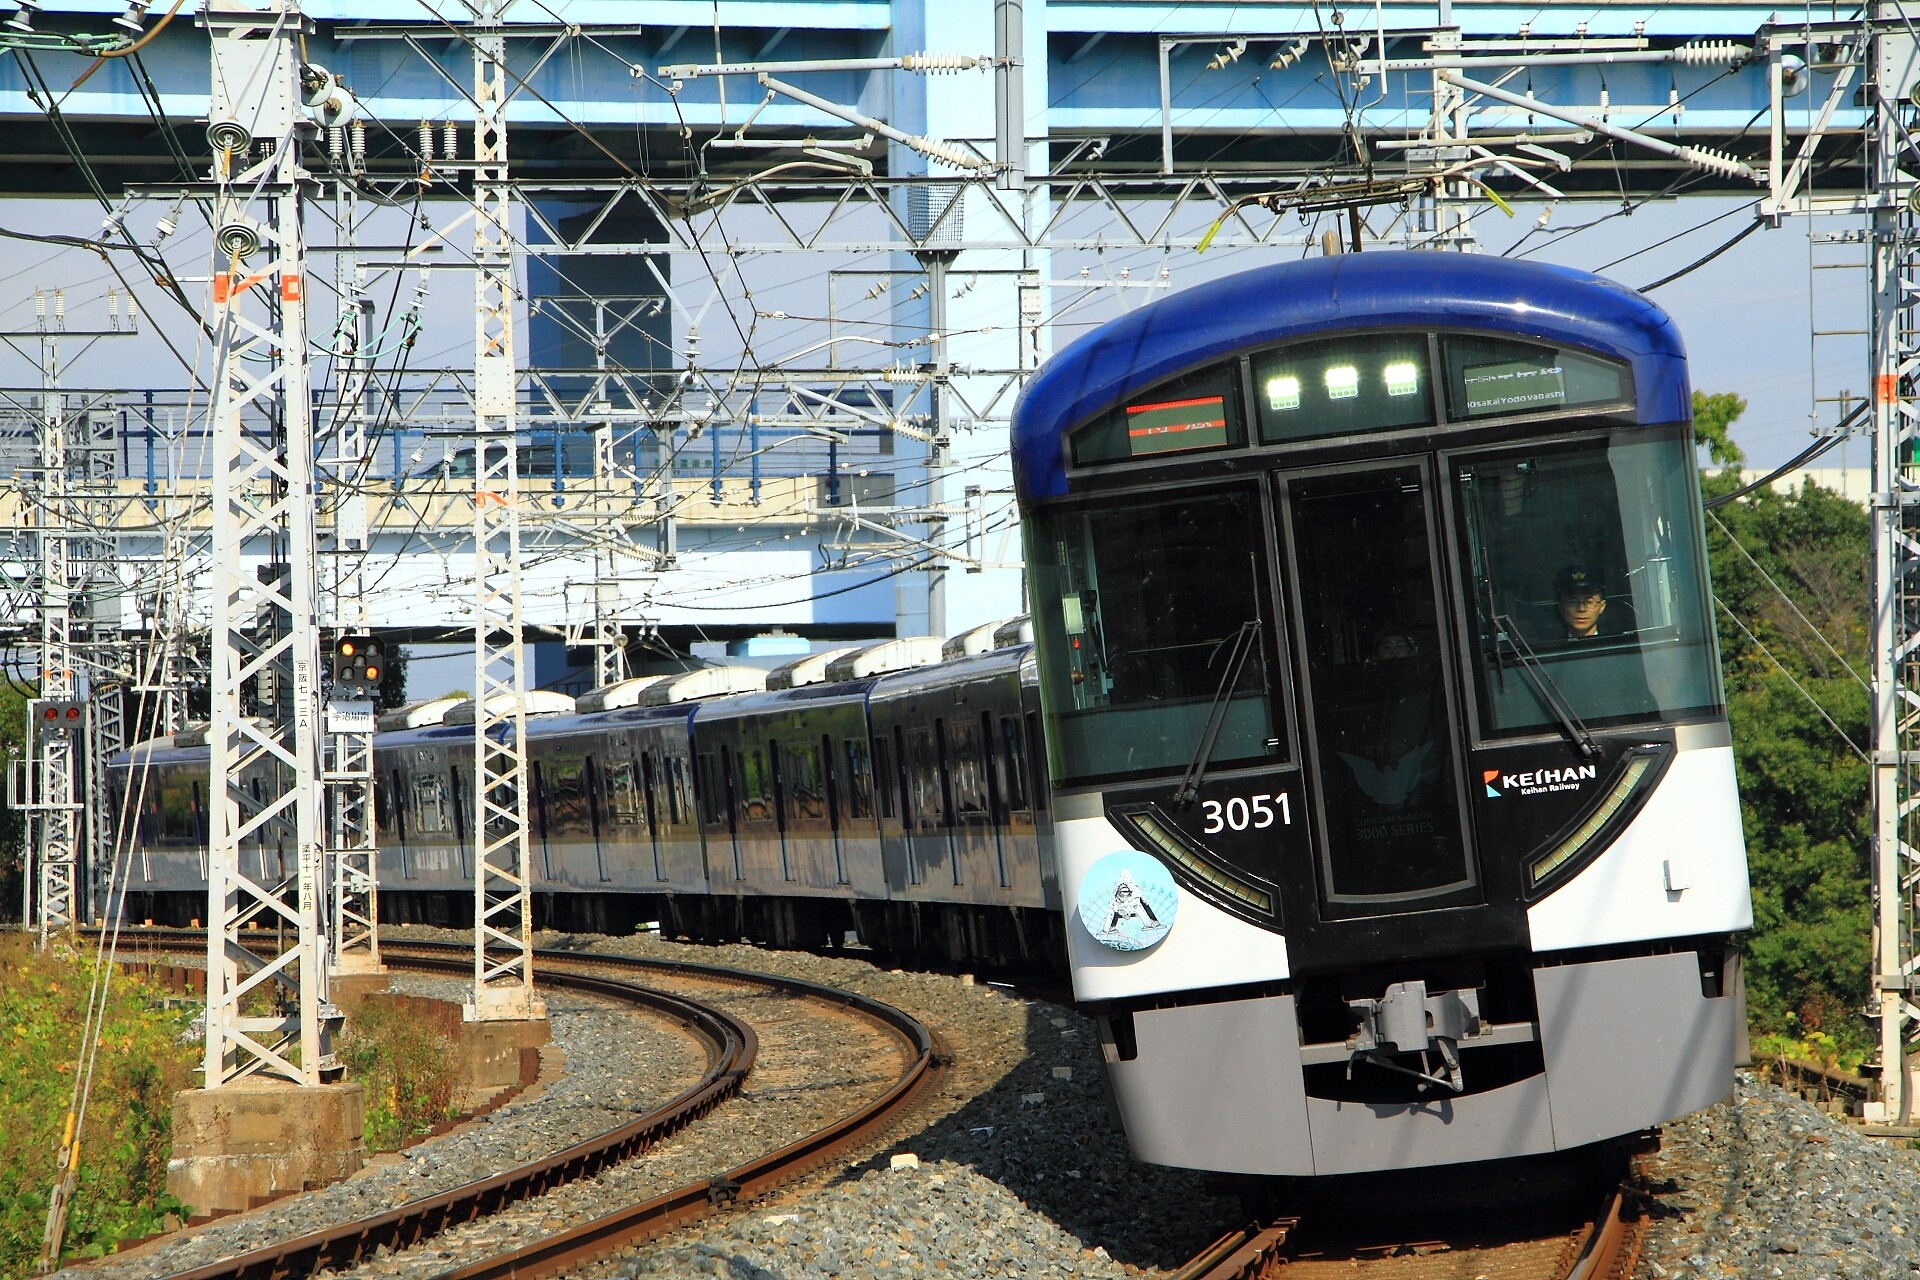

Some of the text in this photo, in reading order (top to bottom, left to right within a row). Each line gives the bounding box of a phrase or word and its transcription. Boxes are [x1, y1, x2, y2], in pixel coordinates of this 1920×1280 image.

[298, 662, 308, 728] 京阪七一三A
[1502, 764, 1596, 789] KEIHAN
[1521, 782, 1580, 796] Keihan Railway
[1202, 792, 1291, 834] 3051
[1356, 821, 1434, 841] 3000 SERIES
